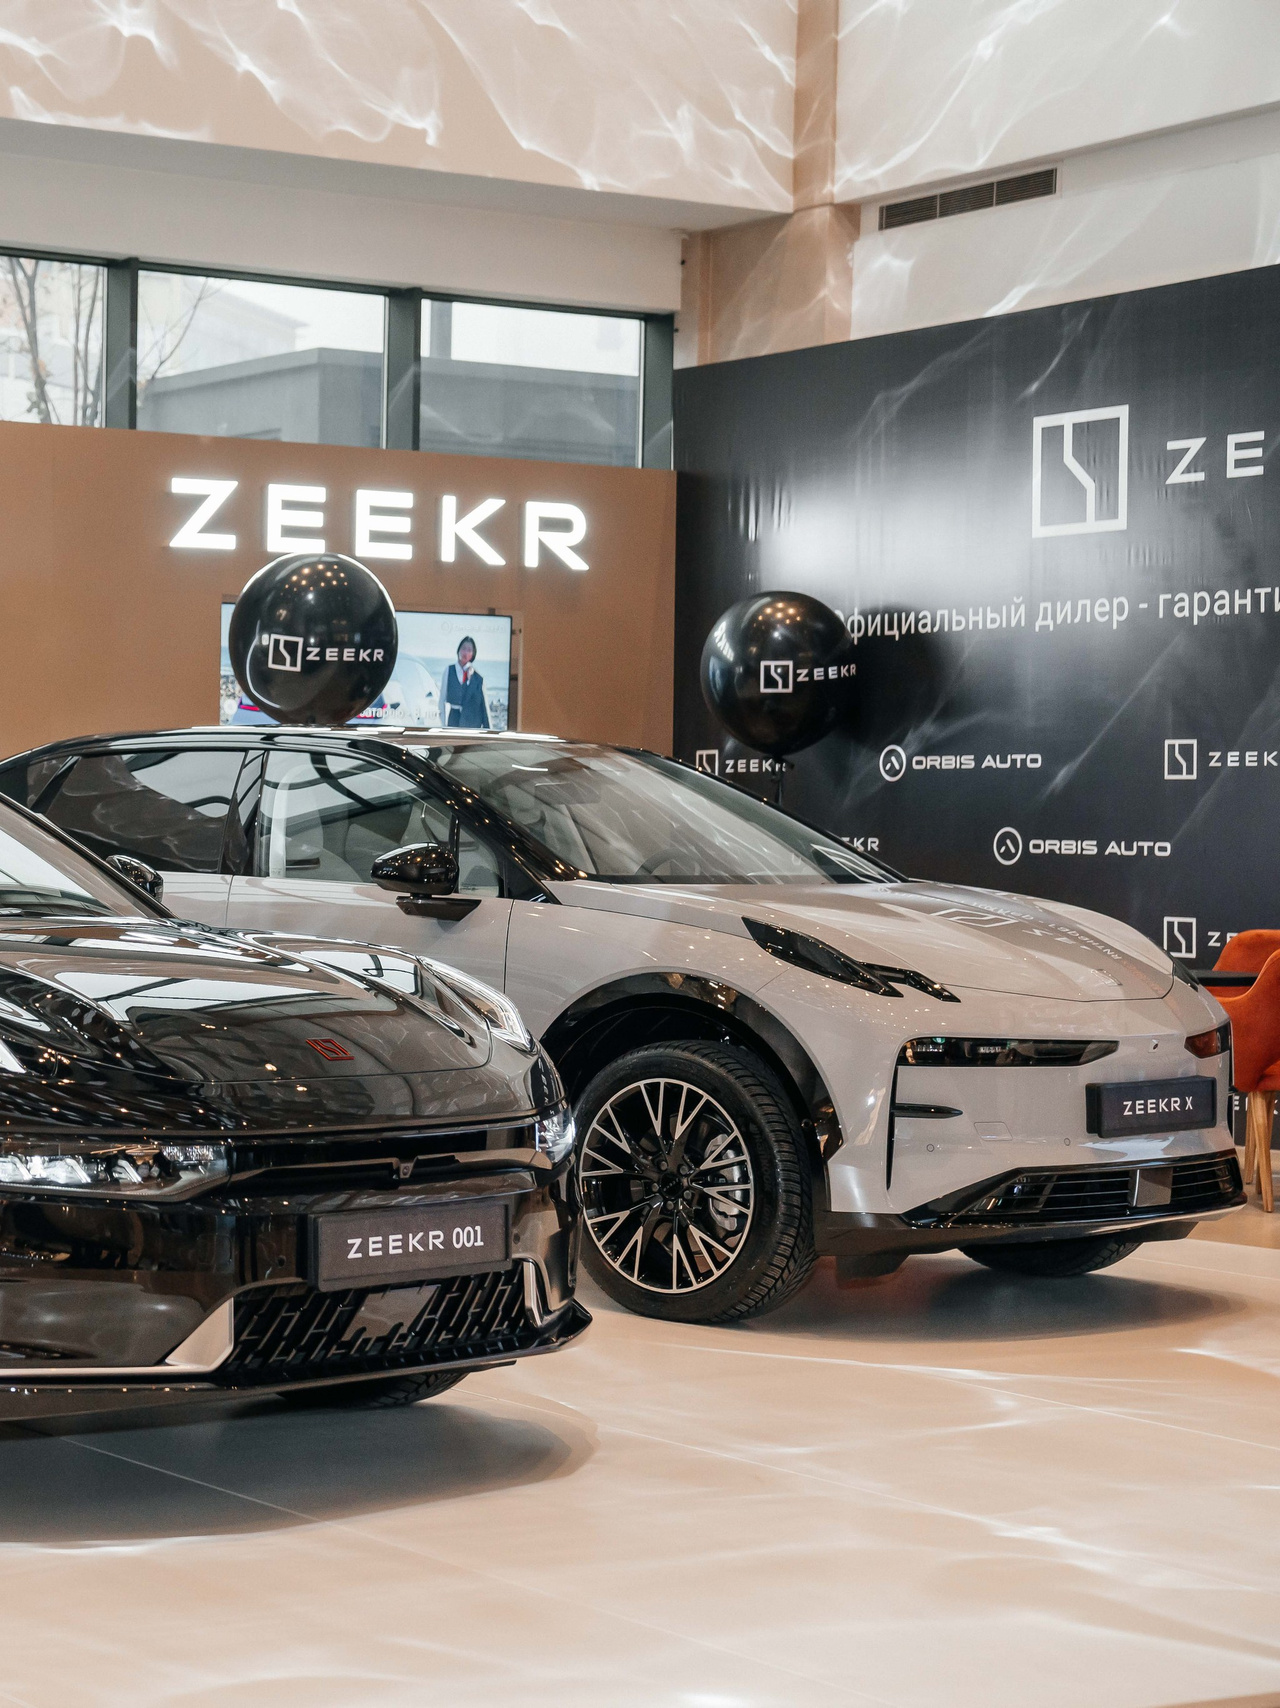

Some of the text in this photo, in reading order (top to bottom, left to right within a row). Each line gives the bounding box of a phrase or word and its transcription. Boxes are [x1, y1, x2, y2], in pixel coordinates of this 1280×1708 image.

[168, 477, 590, 571] ZEEKR
[1035, 596, 1129, 632] дилер
[305, 646, 385, 662] ZEEKR
[796, 663, 857, 682] ZEEKR
[912, 753, 1042, 770] ORBIS AUTO
[1028, 839, 1171, 857] ORBIS AUTO
[1122, 1095, 1193, 1116] ZEEKR X
[346, 1225, 485, 1260] ZEEKR 001
